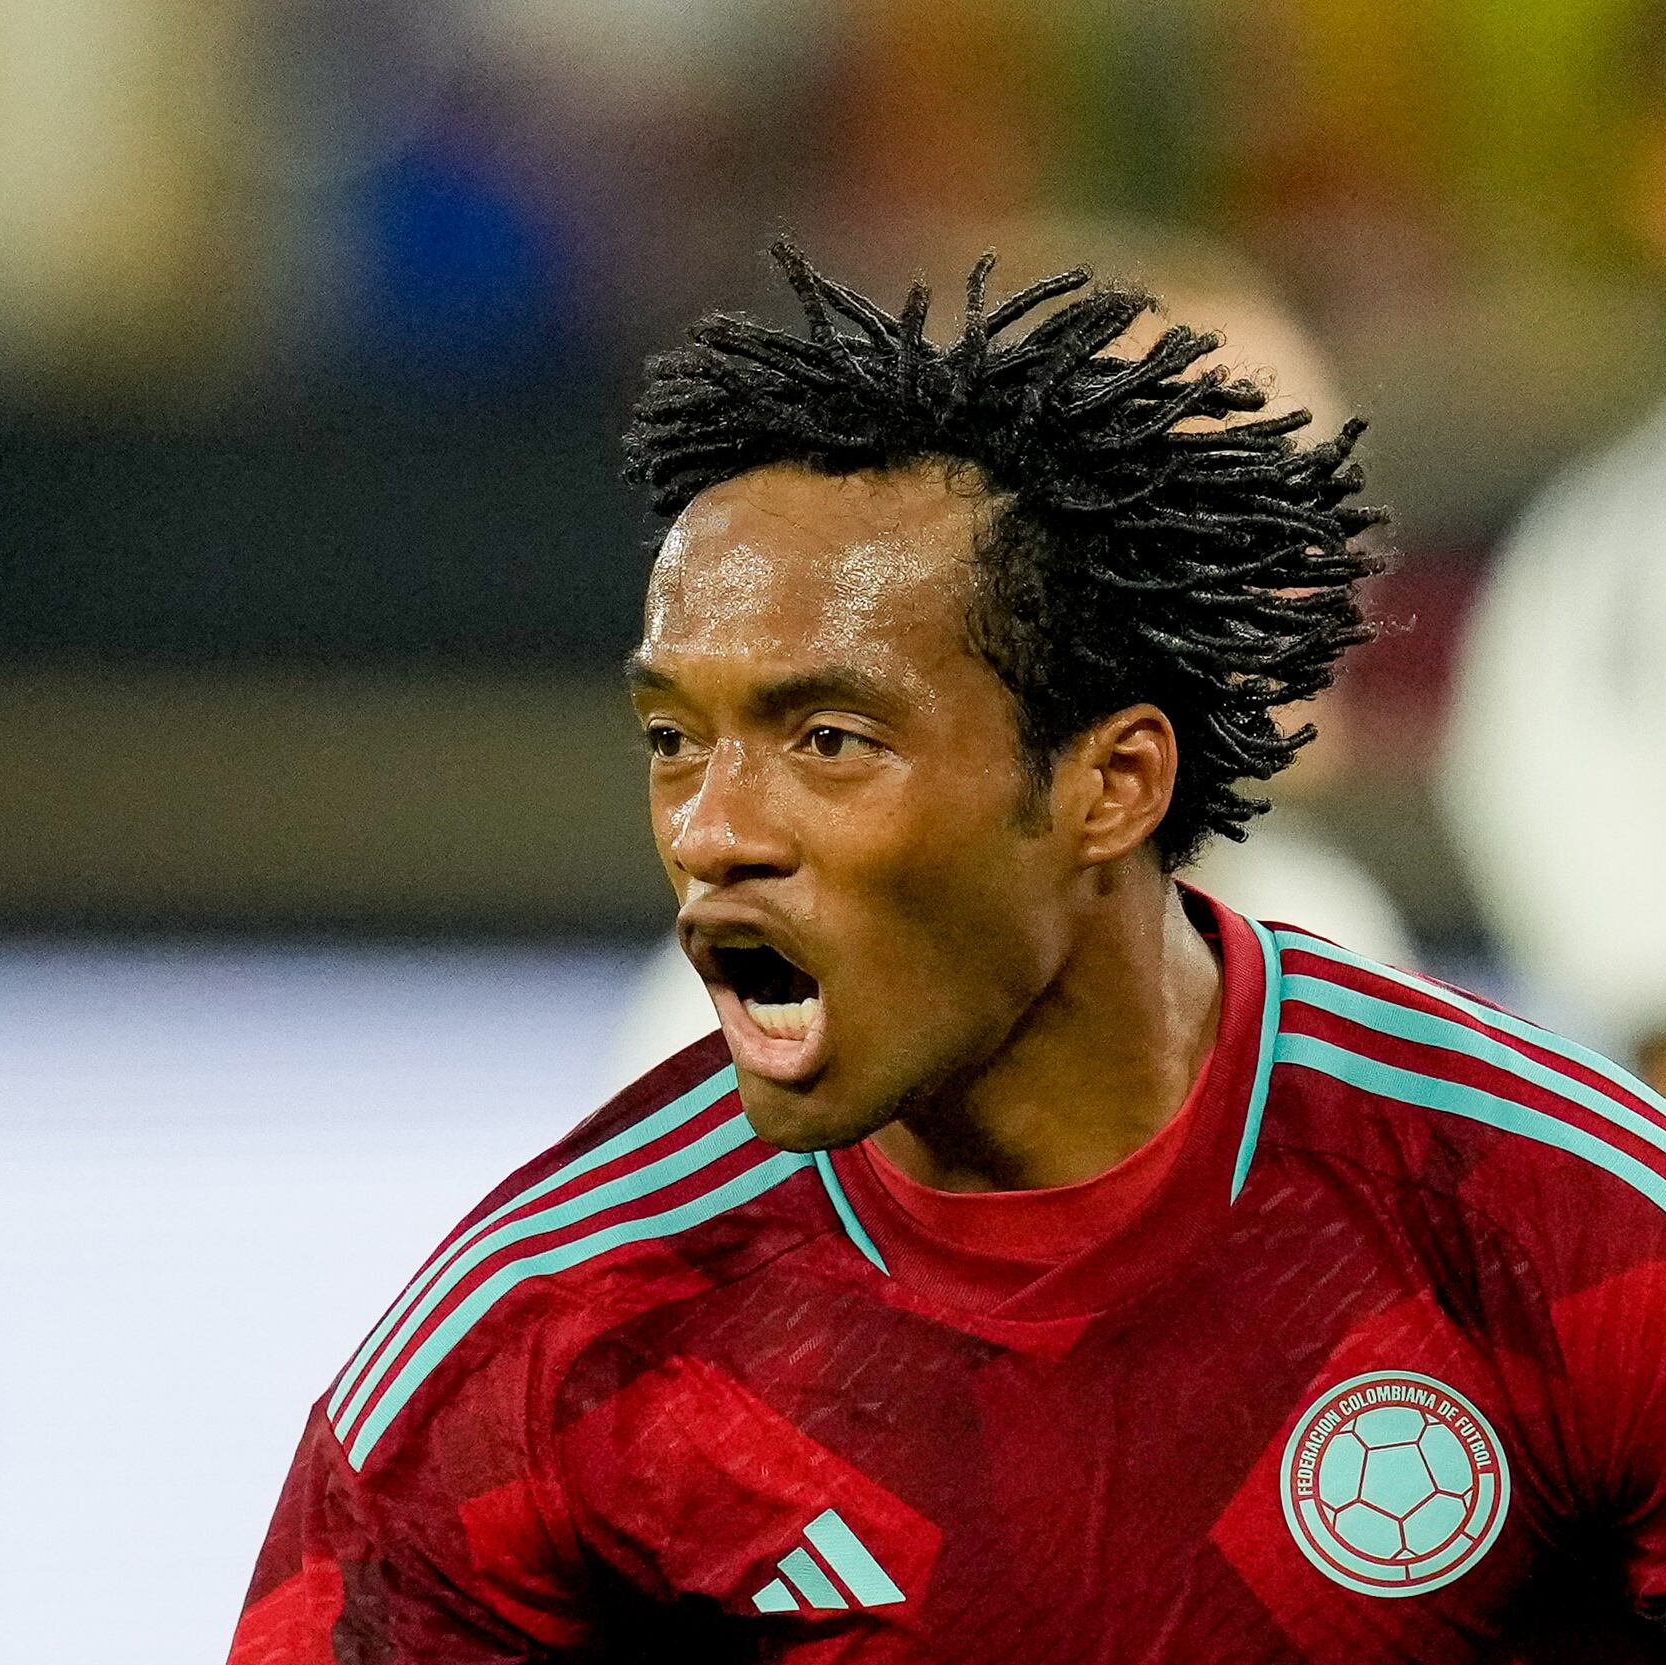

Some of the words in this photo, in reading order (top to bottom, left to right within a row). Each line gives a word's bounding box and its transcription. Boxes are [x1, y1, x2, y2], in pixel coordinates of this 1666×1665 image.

[1297, 1410, 1342, 1496] FEDERACION
[1338, 1385, 1437, 1416] COLOMBIANA
[1437, 1400, 1459, 1422] DE
[1454, 1417, 1492, 1469] FUTBOL
